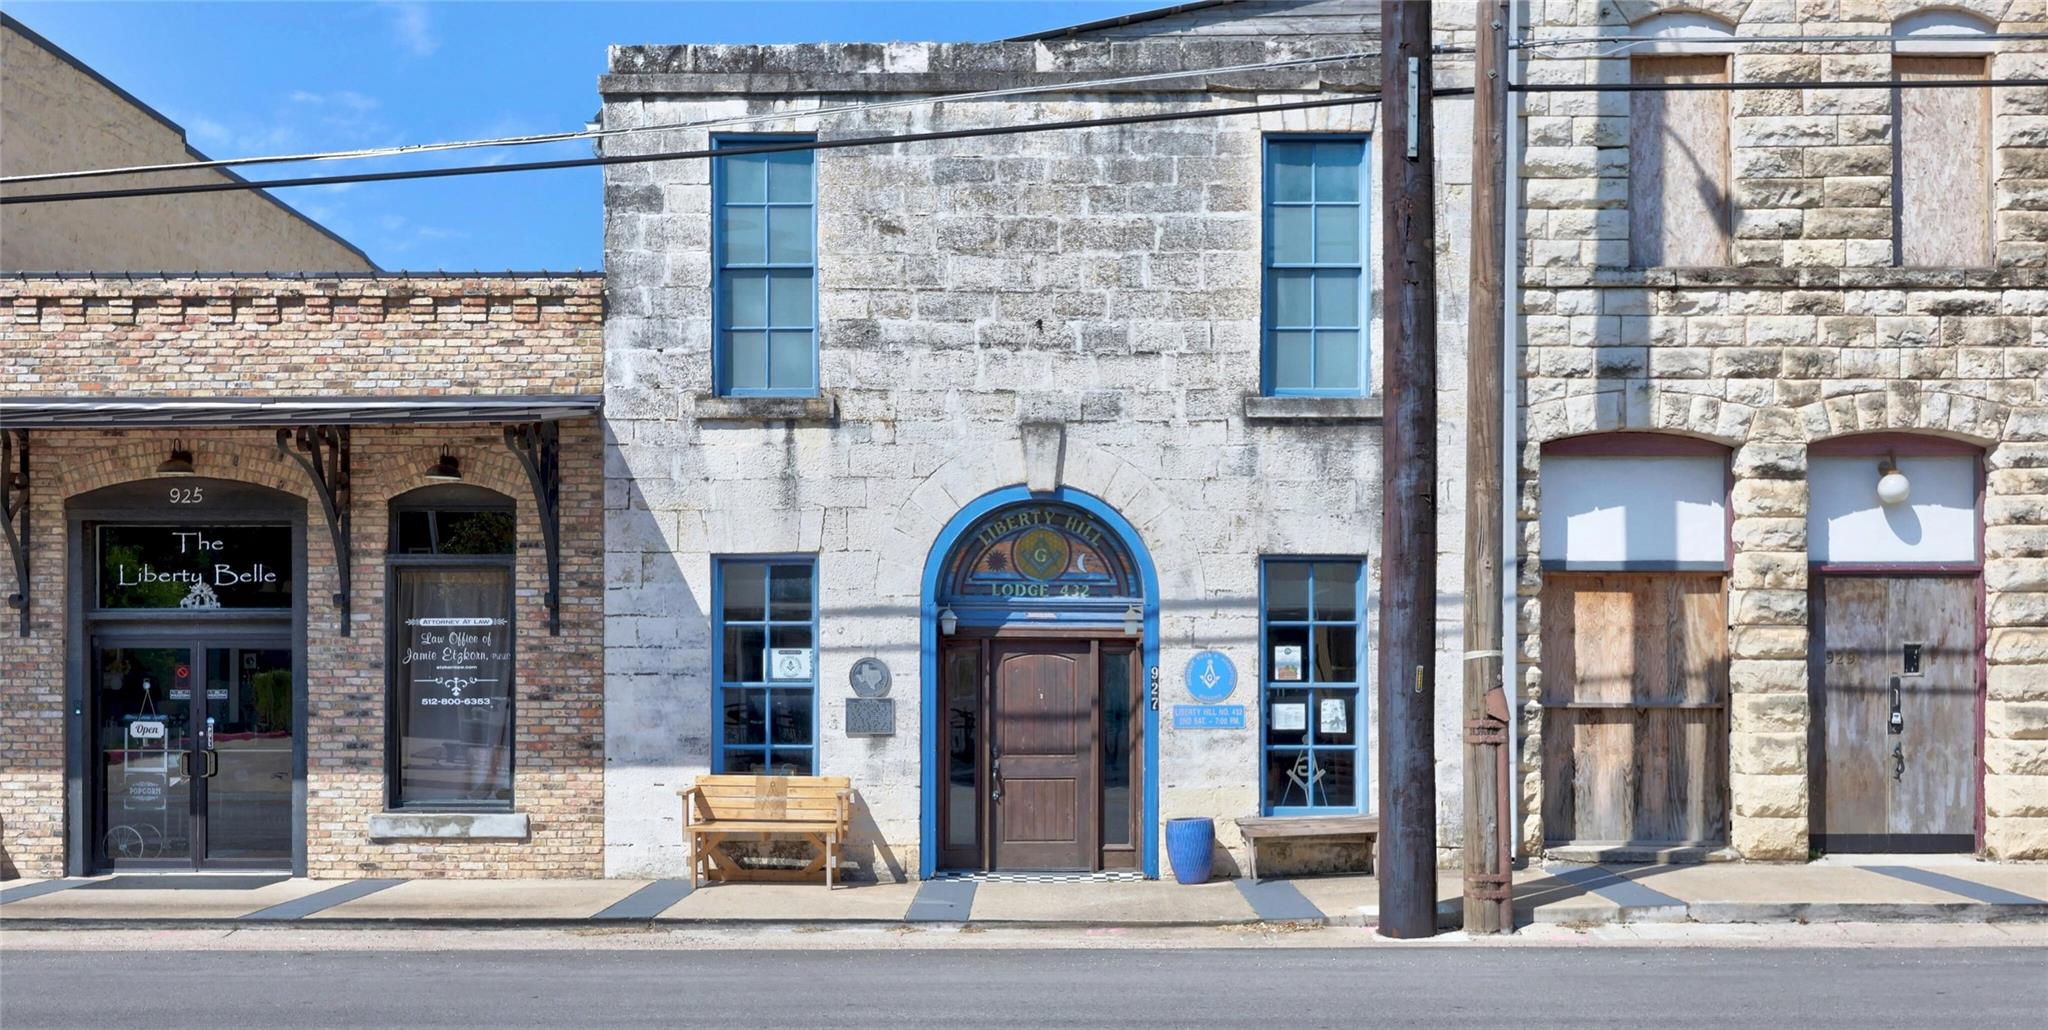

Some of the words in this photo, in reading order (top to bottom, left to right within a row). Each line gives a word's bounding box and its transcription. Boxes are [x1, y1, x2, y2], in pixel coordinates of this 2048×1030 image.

[169, 487, 204, 504] 925
[979, 511, 1055, 545] LIBERTY
[1064, 516, 1104, 547] HILL
[172, 531, 224, 554] The
[1034, 548, 1047, 562] G
[119, 563, 203, 586] Liberty
[214, 563, 277, 586] Belle
[992, 583, 1049, 597] LODGE
[1060, 584, 1090, 597] 432
[420, 632, 445, 645] Law
[449, 632, 479, 646] Office
[482, 632, 492, 647] of
[402, 647, 437, 664] Jamie
[135, 724, 158, 735] Open
[129, 787, 161, 795] POPCORN
